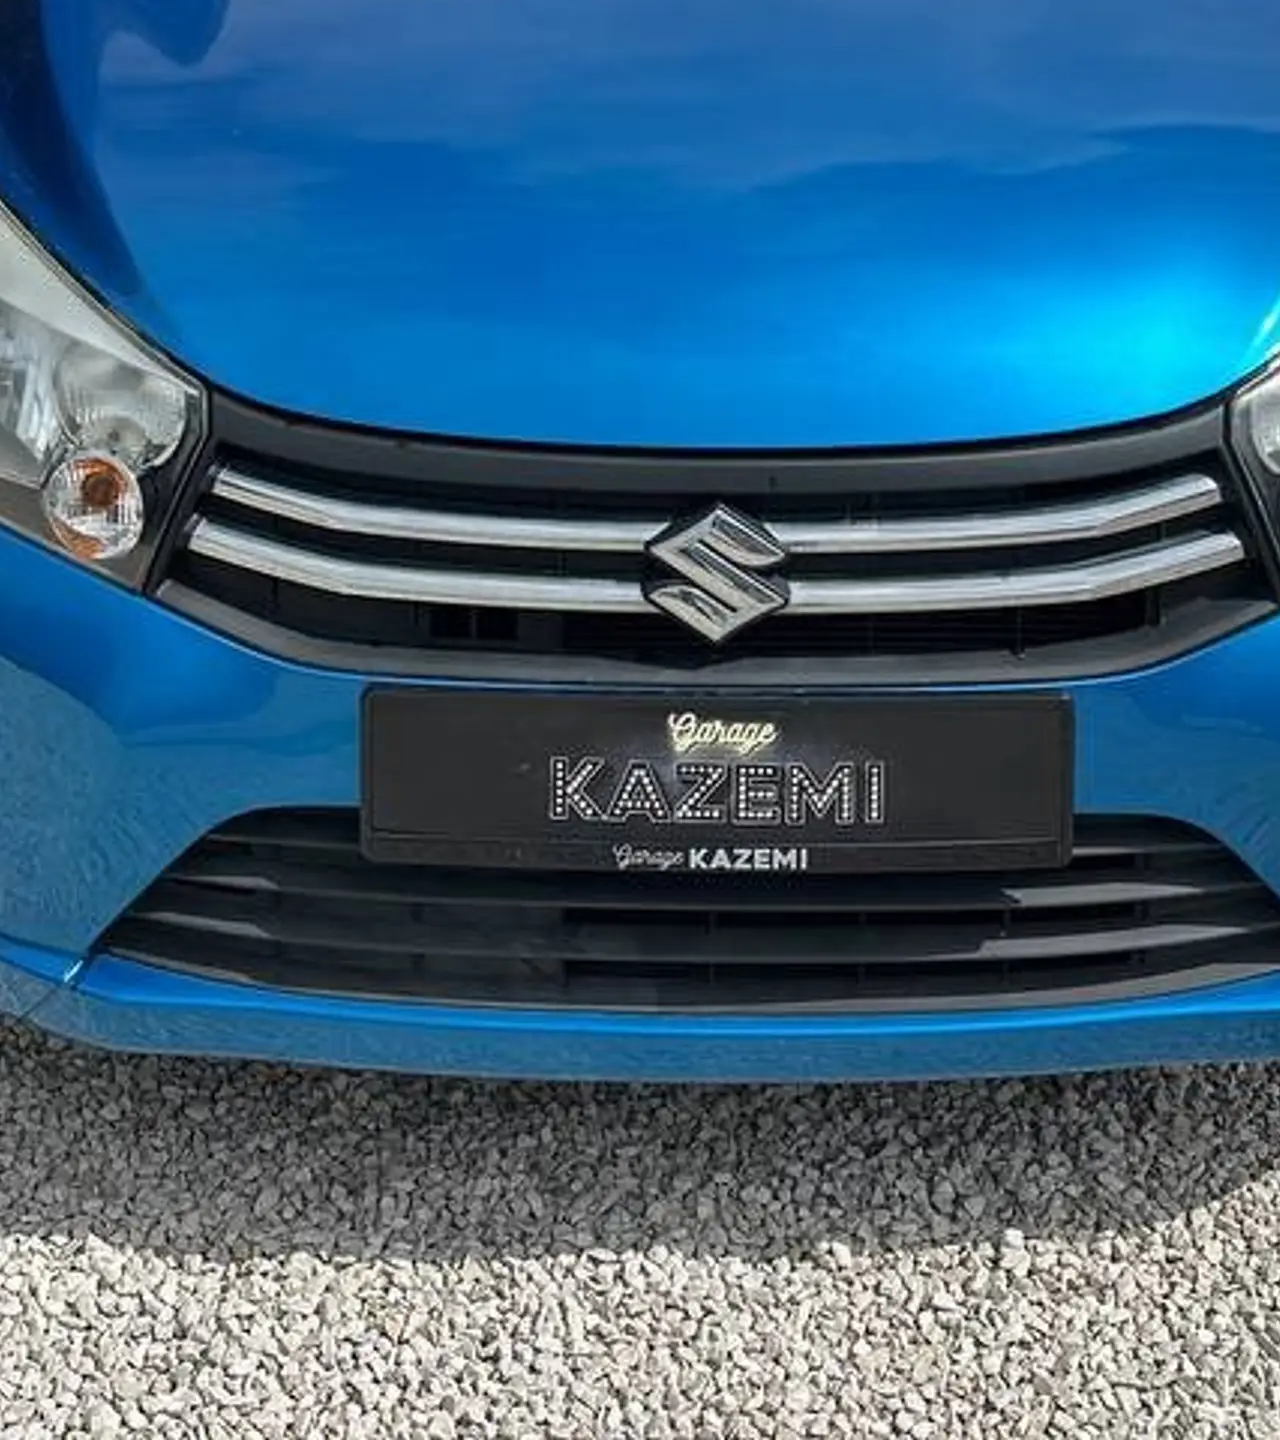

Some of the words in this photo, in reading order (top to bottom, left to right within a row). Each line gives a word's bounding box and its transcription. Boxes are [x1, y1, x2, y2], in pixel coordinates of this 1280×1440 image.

[667, 712, 778, 754] Garage
[549, 756, 885, 825] KAZEMI
[612, 843, 685, 870] Garage
[688, 848, 808, 870] KAZEMI
